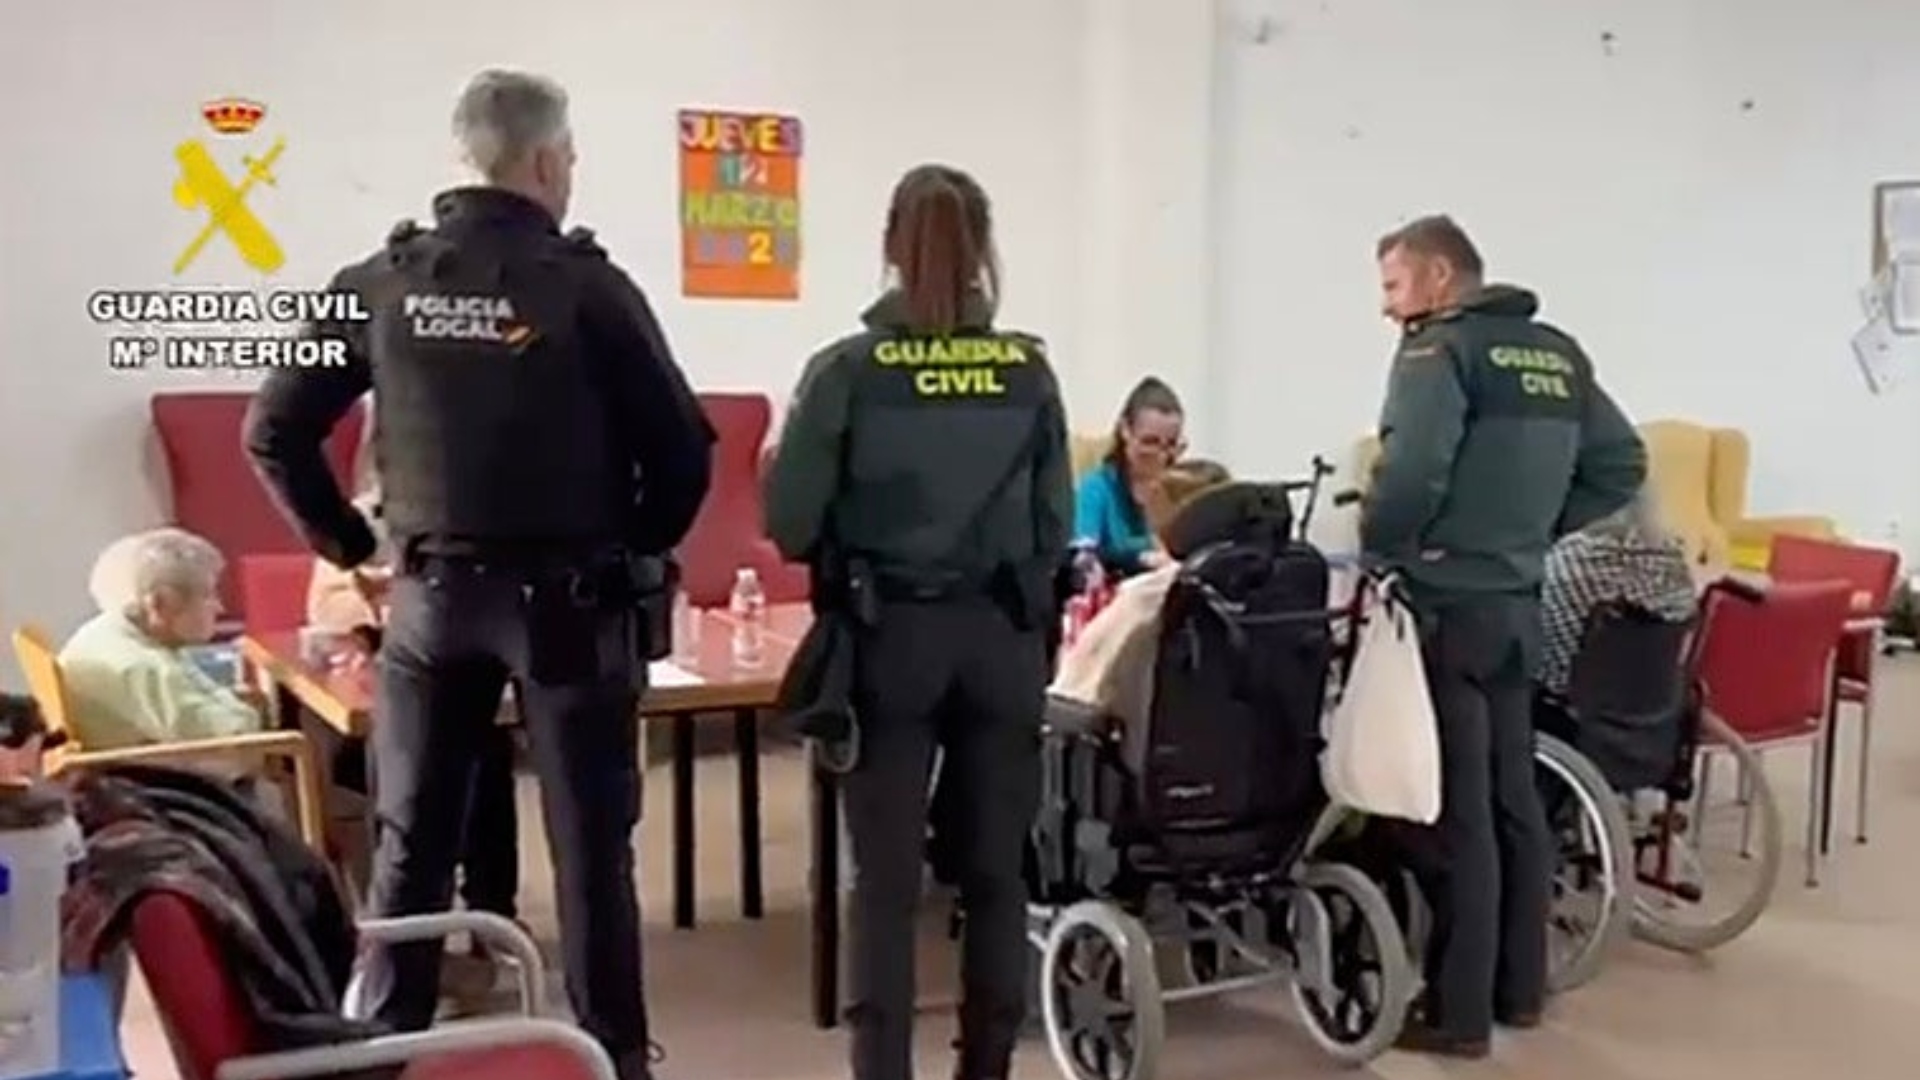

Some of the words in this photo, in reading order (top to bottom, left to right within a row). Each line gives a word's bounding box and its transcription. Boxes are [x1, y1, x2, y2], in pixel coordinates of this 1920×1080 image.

[685, 191, 798, 228] MARZO
[413, 316, 503, 340] LOCAL
[874, 339, 1027, 364] GUARDIA
[915, 367, 1006, 395] CIVIL
